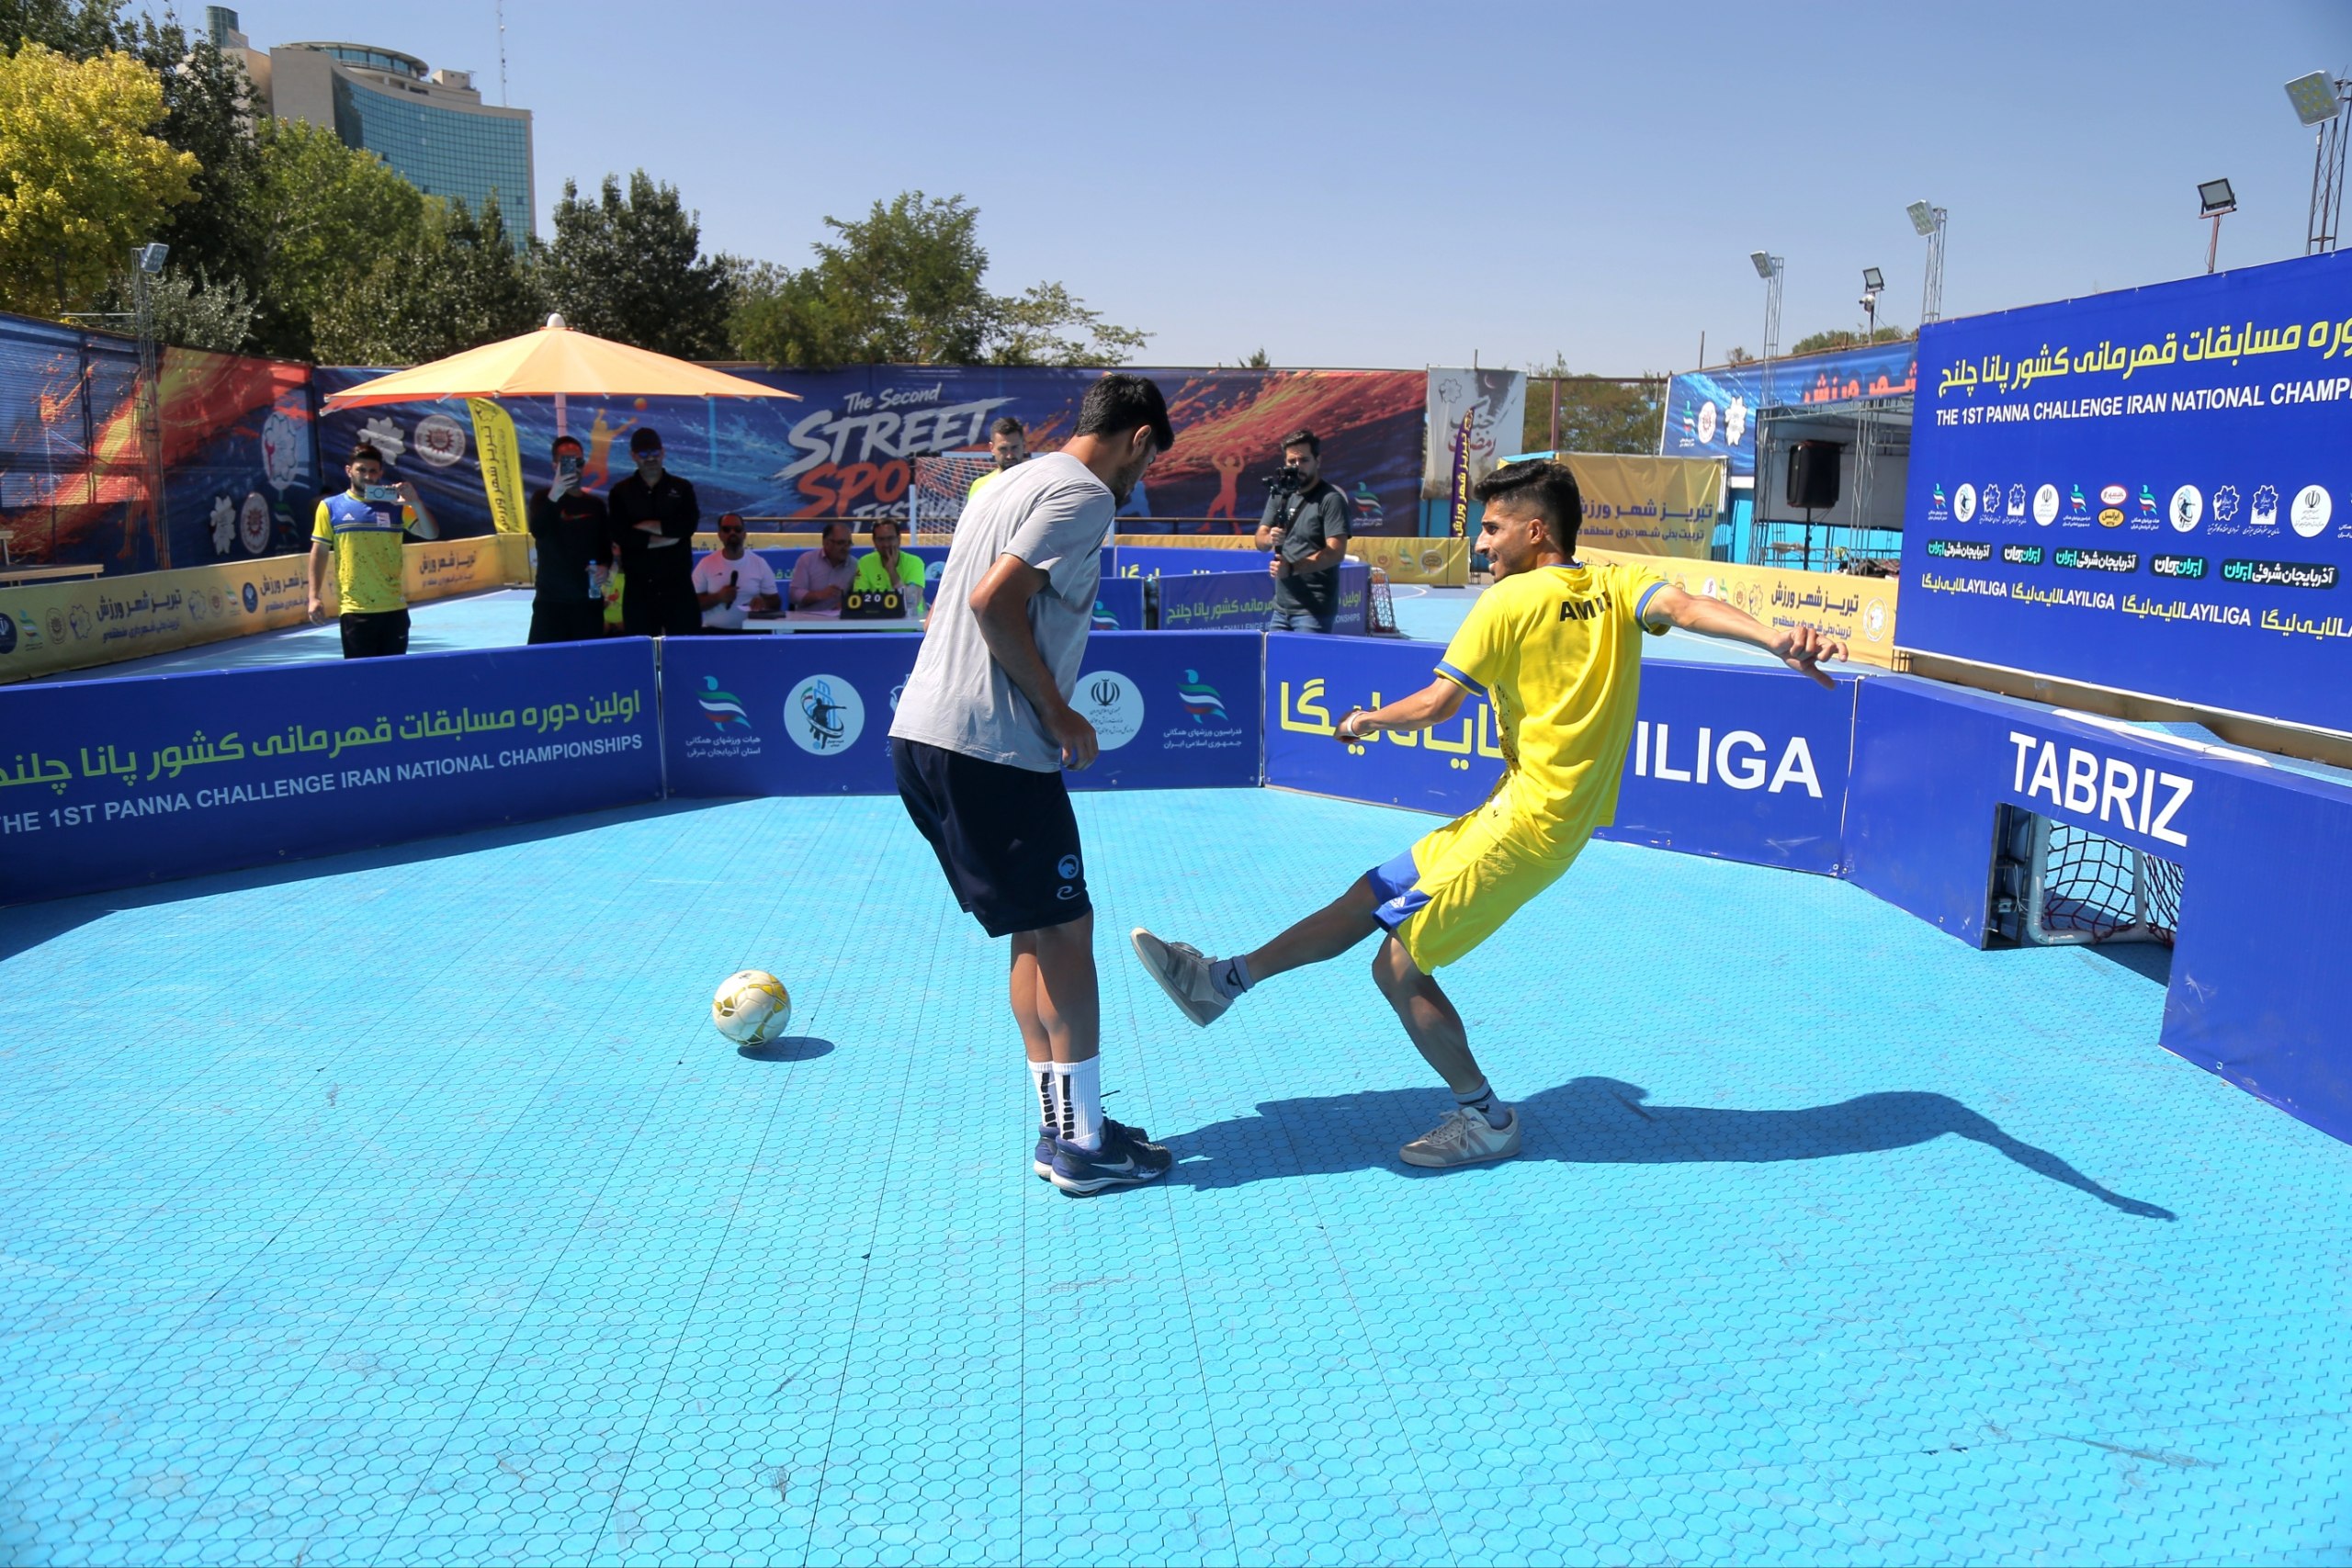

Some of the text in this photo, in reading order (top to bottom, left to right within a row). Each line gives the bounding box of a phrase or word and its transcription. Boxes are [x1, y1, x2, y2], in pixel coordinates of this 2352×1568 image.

[1939, 318, 2352, 398] وره مسابقات قهرمانی کشور پانا چلنج
[843, 382, 942, 413] The Second
[1937, 409, 1959, 426] THE
[1962, 406, 1984, 424] 1ST
[1985, 403, 2030, 423] PANNA
[2033, 396, 2123, 420] CHALLENGE
[2127, 392, 2166, 414] IRAN
[2171, 385, 2265, 412] NATIONAL
[772, 397, 1021, 480] STREET
[1457, 472, 1467, 502] شهر
[1453, 503, 1466, 537] ورزش
[1616, 499, 1657, 520] شهر
[1660, 502, 1713, 523] تبریز
[848, 594, 862, 609] 0
[865, 594, 871, 603] 2
[884, 594, 898, 609] 0
[1771, 581, 1859, 617] تبریز شهر ورزش
[1962, 578, 2007, 597] LAYILIGA
[2059, 589, 2115, 610] LAYILIGA
[2181, 603, 2251, 626] LAYILIGA
[0, 689, 640, 795] اولین دوره مسابقات قهرمانی کشور پانا چلن
[1635, 720, 1823, 798] ILIGA
[0, 734, 642, 834] HE 1ST PANNA CHALLENGE IRAN NATIONAL CHAMPIONSHIPS
[2009, 731, 2193, 847] TABRIZ
